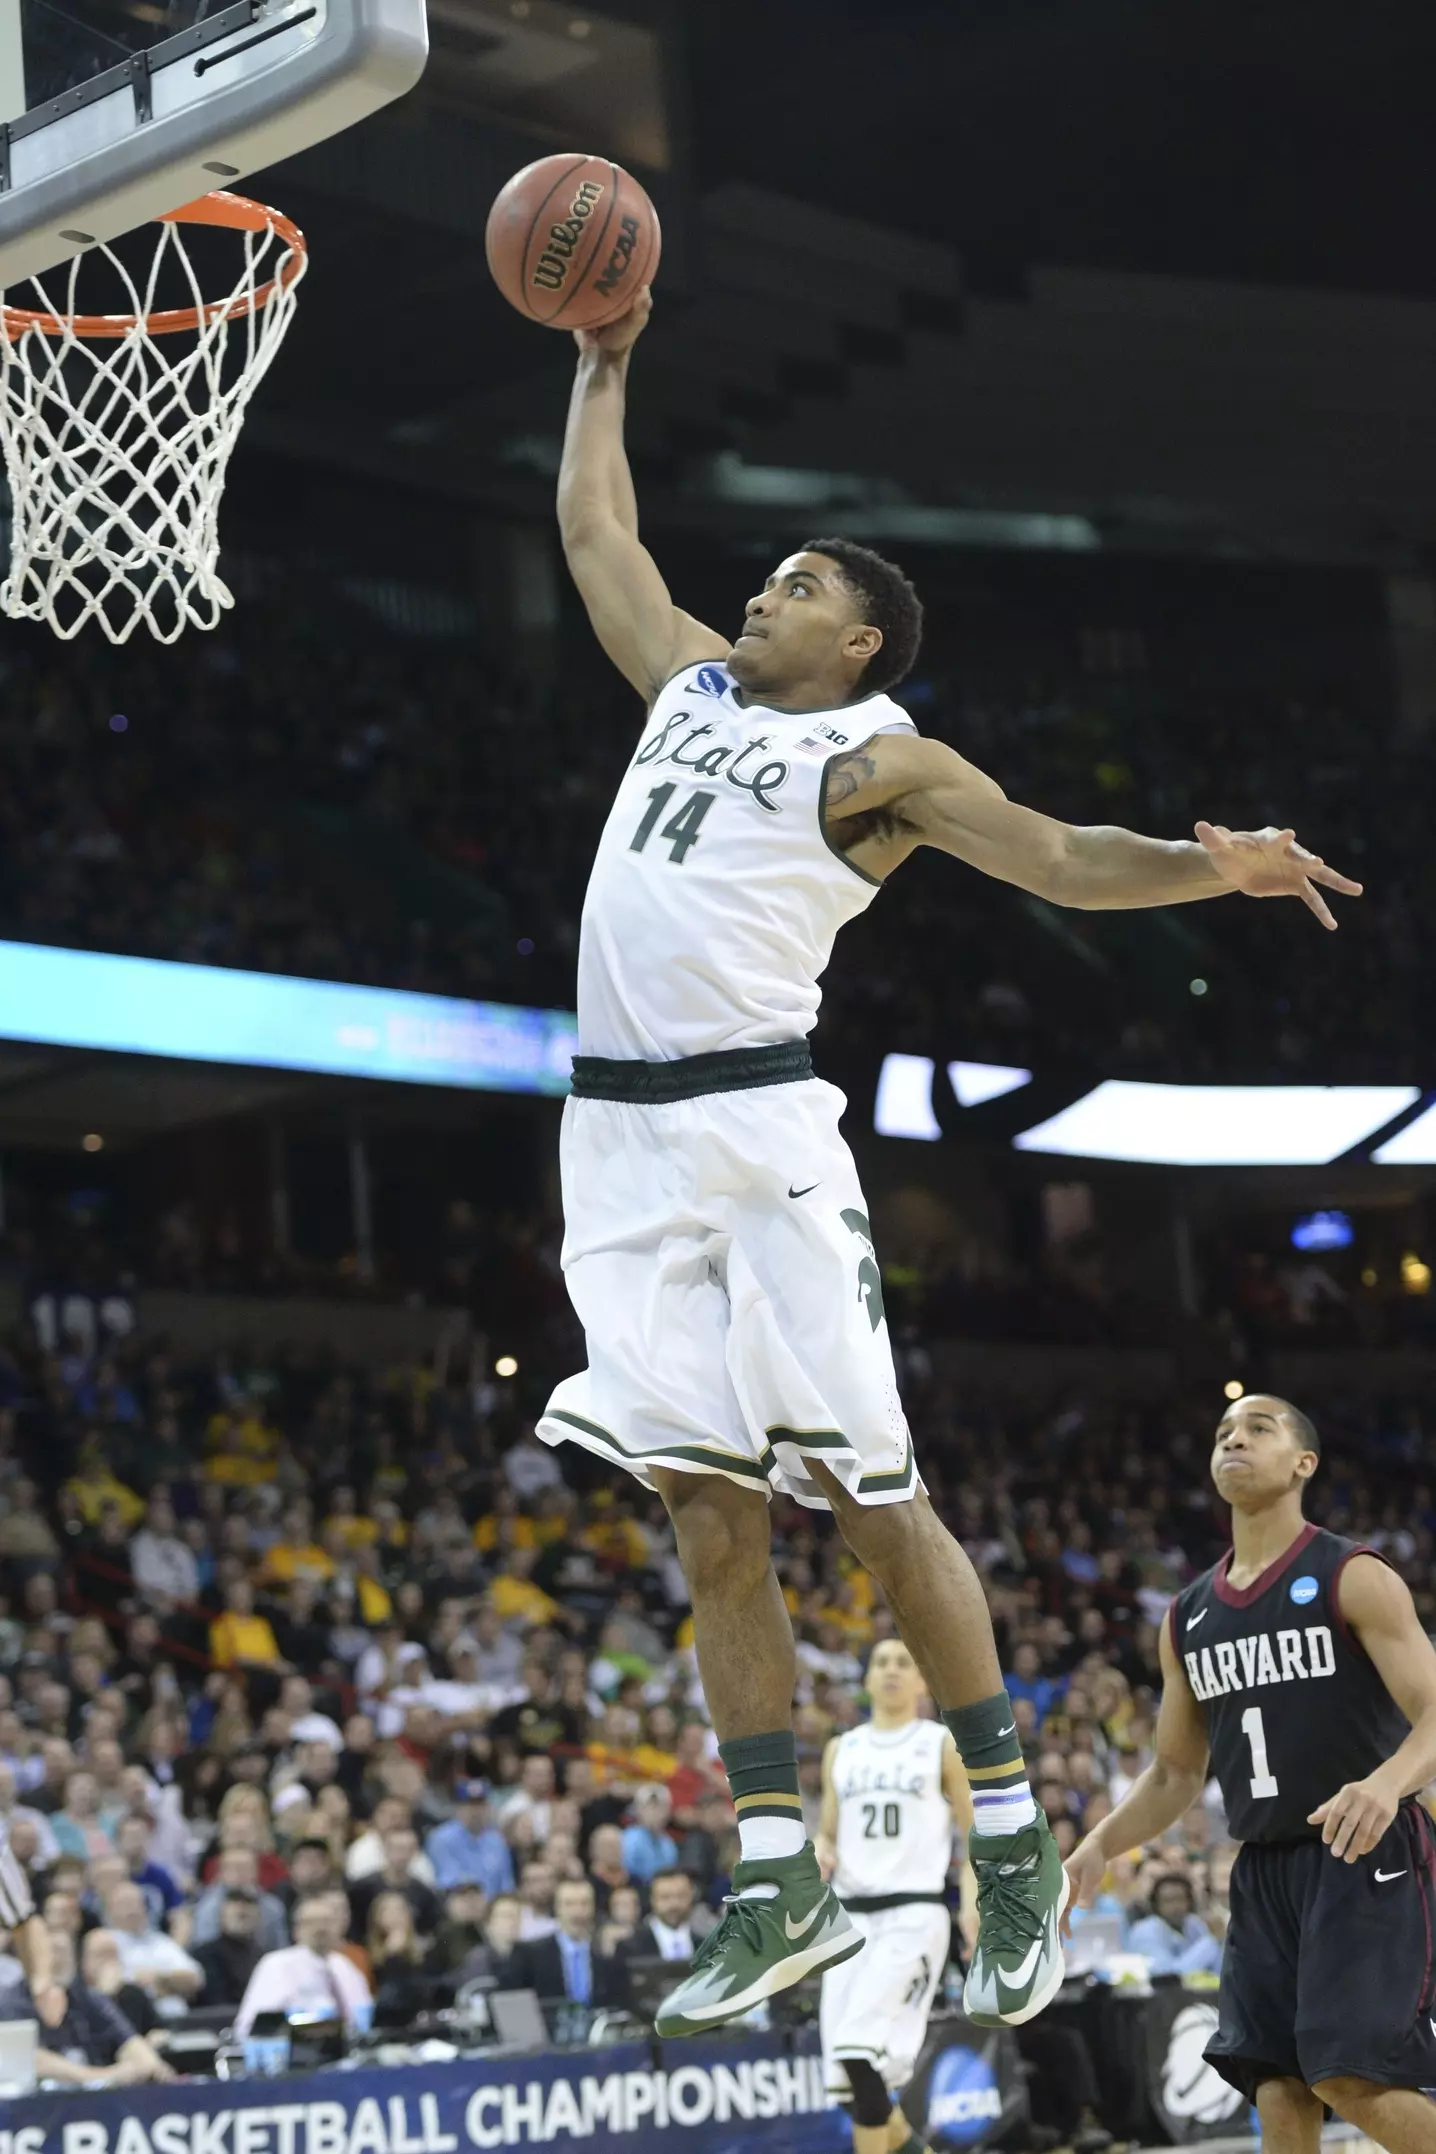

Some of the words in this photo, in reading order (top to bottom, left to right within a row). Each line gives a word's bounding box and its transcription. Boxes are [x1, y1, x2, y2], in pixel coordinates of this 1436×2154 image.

[532, 180, 605, 292] Wilson
[593, 215, 640, 297] NCAA
[632, 711, 788, 815] State
[629, 780, 717, 865] 14
[1184, 1625, 1336, 1702] HARVARD
[1241, 1706, 1279, 1800] 1
[861, 1803, 901, 1839] 20
[62, 2093, 459, 2154] BASKETBALL
[465, 2054, 826, 2149] CHAMPIONSHI
